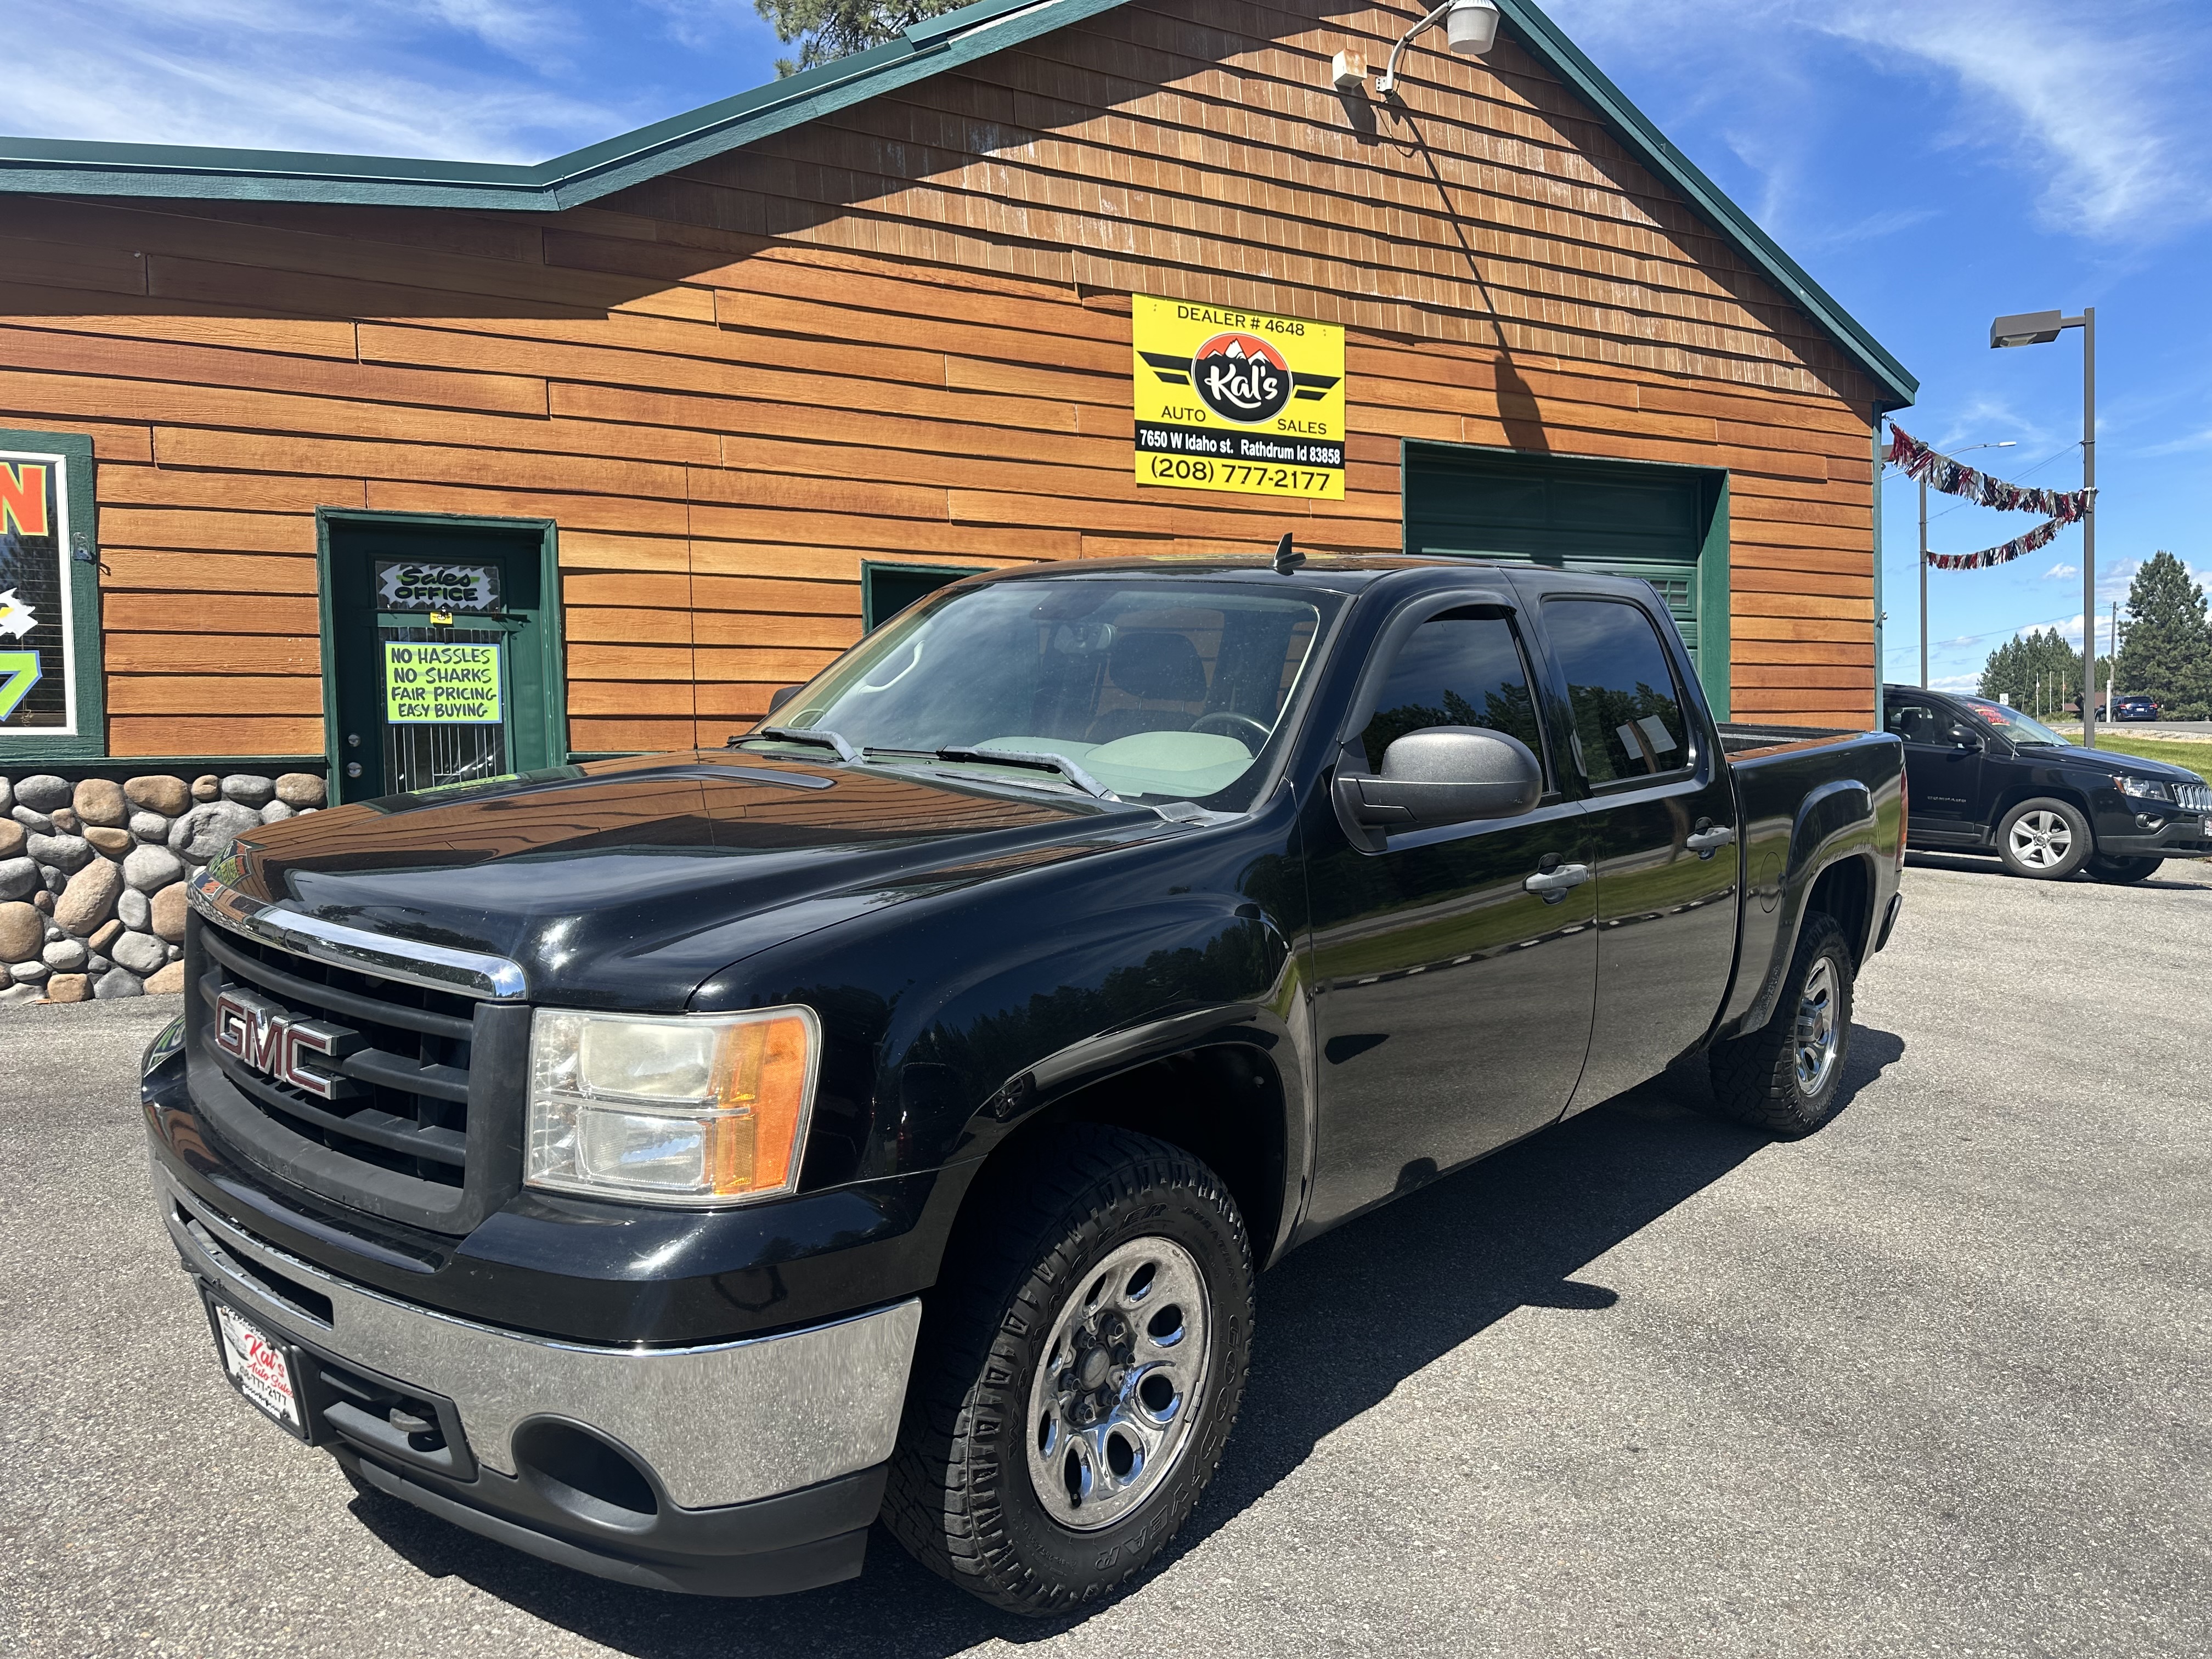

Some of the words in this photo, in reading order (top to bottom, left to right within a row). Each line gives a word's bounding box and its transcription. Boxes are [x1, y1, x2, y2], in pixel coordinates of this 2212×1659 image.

[1177, 305, 1245, 328] DEALER
[1250, 317, 1261, 330] #
[1265, 319, 1305, 336] 4648
[1204, 364, 1278, 409] Kal's
[1161, 405, 1206, 422] AUTO
[1277, 419, 1327, 435] SALES
[1139, 429, 1167, 447] 7650
[1170, 431, 1183, 449] W
[1185, 433, 1217, 452] Idaho
[1220, 438, 1234, 454] st.
[1240, 439, 1295, 460] Rathdrum
[1296, 445, 1307, 462] Id
[1309, 448, 1340, 465] 83858
[1151, 455, 1214, 483] (208)
[1221, 464, 1330, 491] 777-2177
[401, 568, 471, 588] Sales
[394, 586, 479, 602] OFFICE
[391, 647, 413, 664] NO
[417, 647, 491, 665] HASSLES
[394, 667, 417, 684] NO
[425, 667, 492, 684] SHARKS
[391, 686, 426, 701] FAIR
[433, 686, 497, 702] PRICING
[398, 703, 430, 718] EASY
[434, 702, 488, 718] BUYING
[215, 990, 337, 1100] GMC
[247, 1362, 270, 1381] Auto
